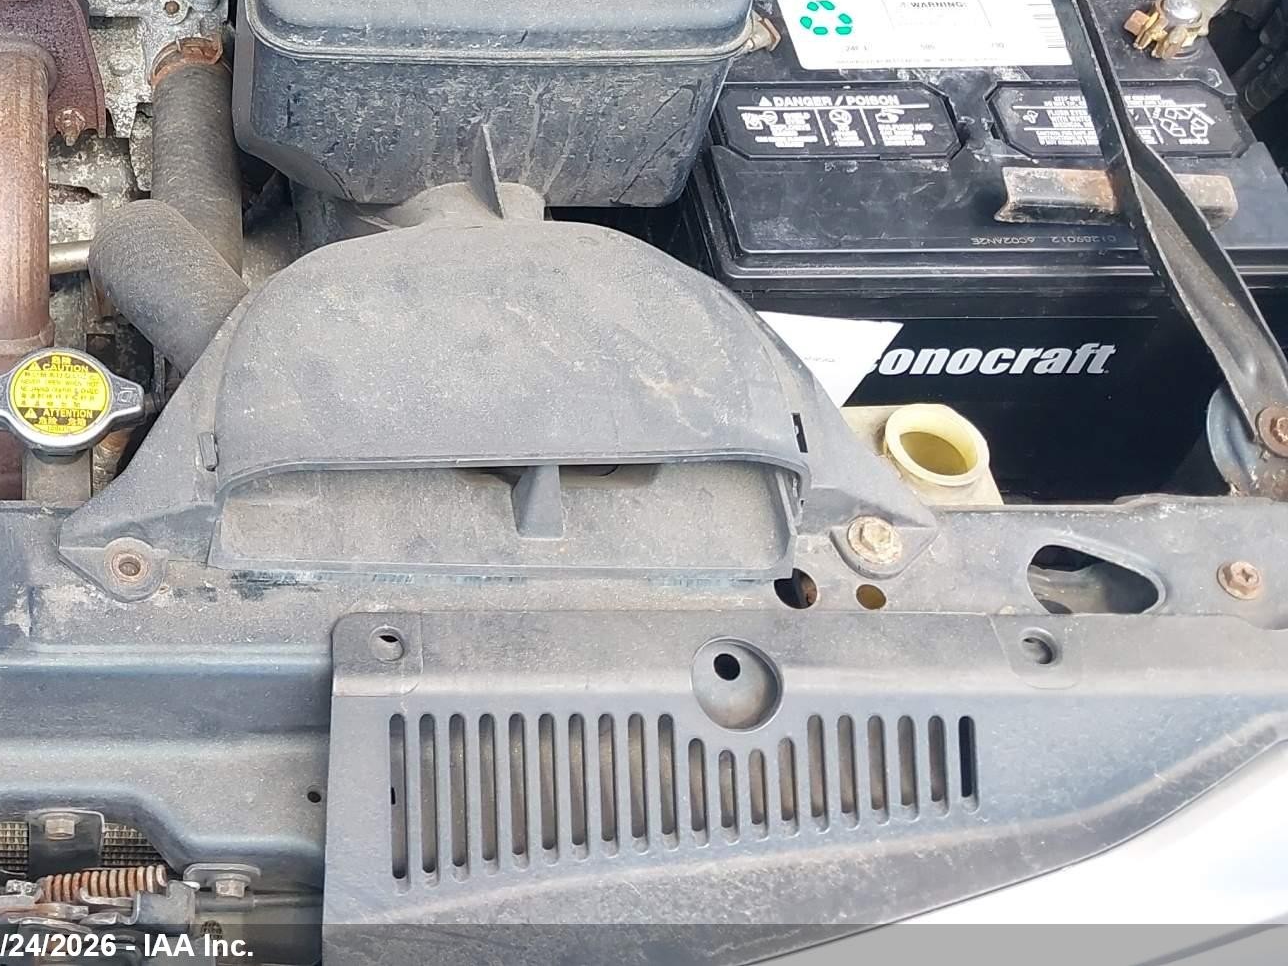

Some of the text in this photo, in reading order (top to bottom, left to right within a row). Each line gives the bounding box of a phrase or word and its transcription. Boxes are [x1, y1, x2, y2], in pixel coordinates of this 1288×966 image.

[772, 96, 832, 107] DANGER
[846, 95, 900, 106] POISON
[43, 364, 89, 372] CAUTION
[42, 408, 93, 419] ATTENTION
